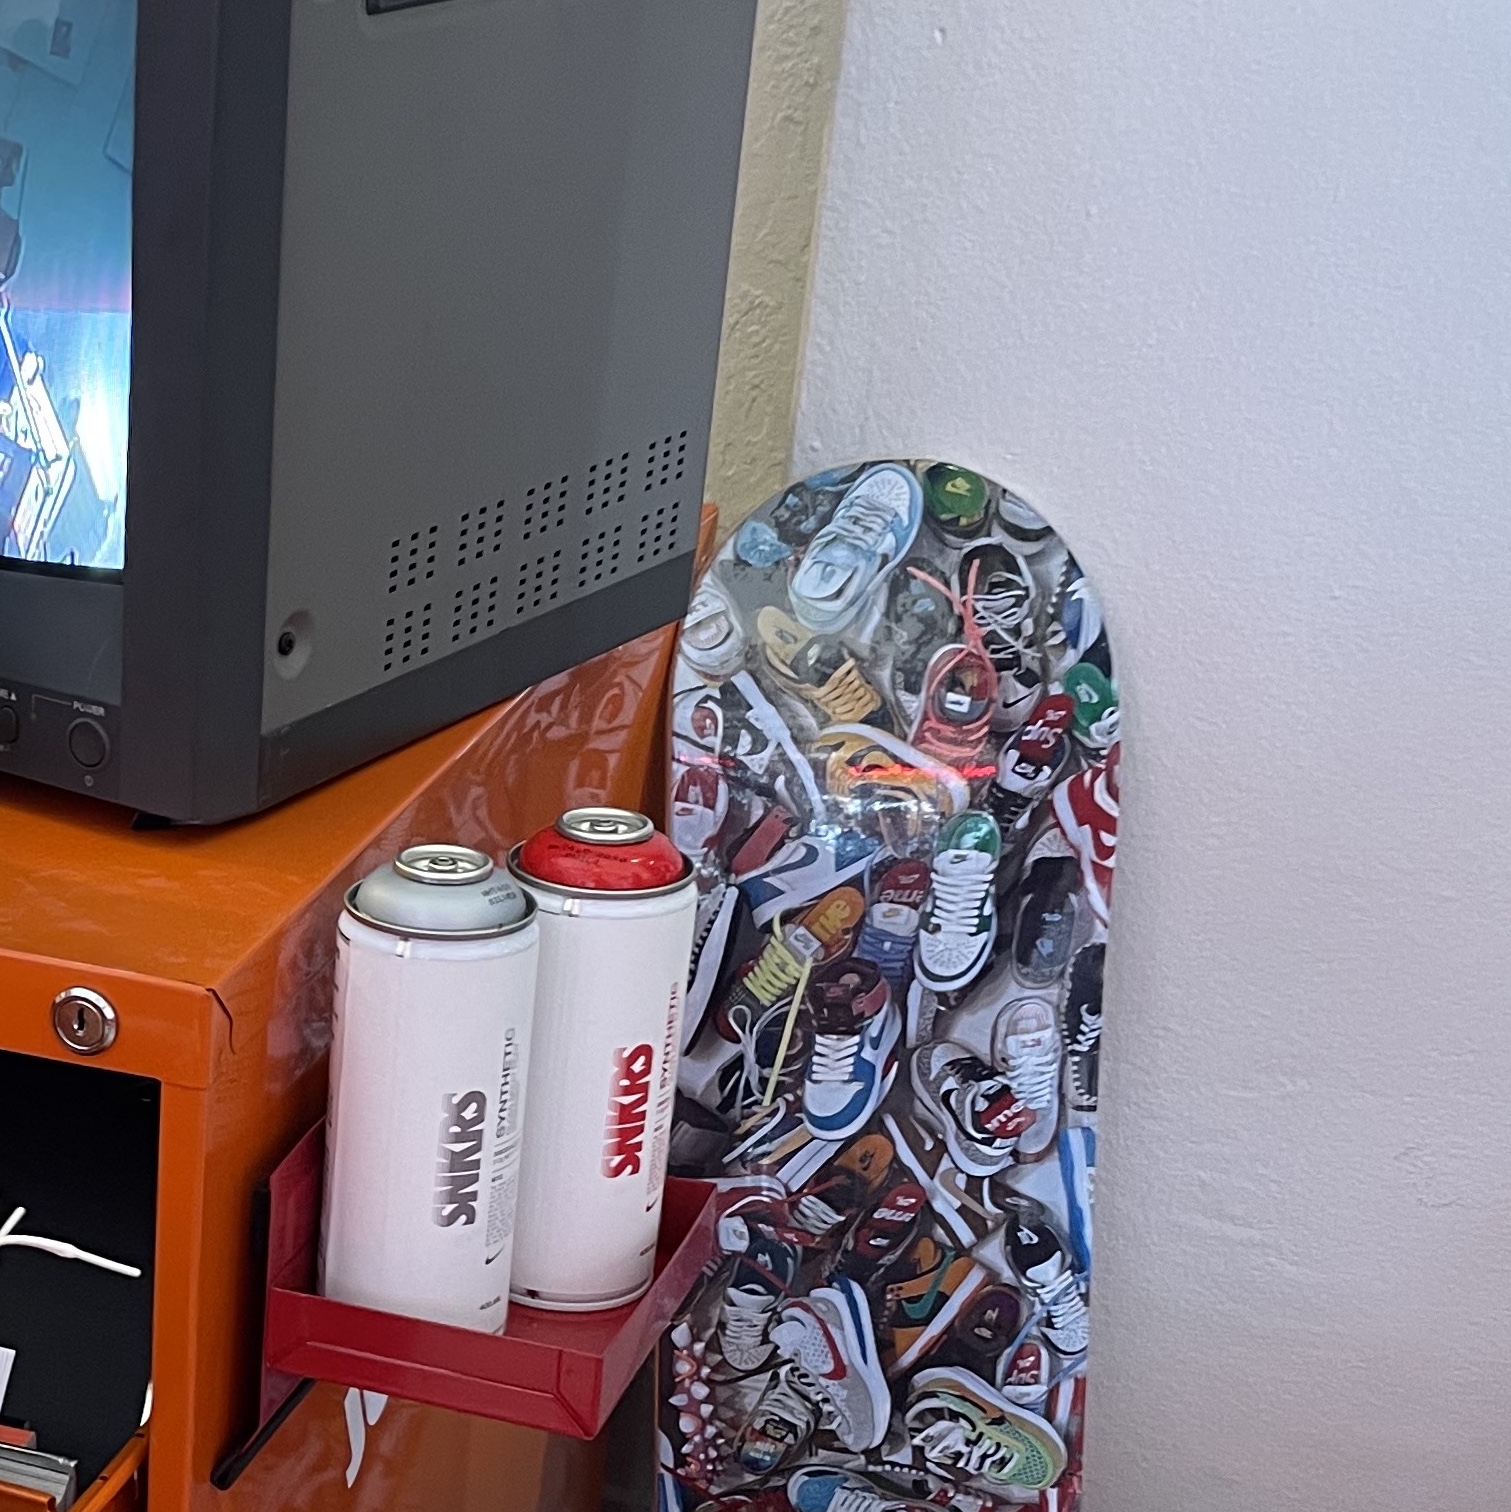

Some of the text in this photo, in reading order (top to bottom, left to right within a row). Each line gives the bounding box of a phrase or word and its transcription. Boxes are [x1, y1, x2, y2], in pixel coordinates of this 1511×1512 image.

[72, 700, 106, 717] POWER
[433, 1089, 488, 1228] SNKRS
[601, 1042, 656, 1179] SNKRS
